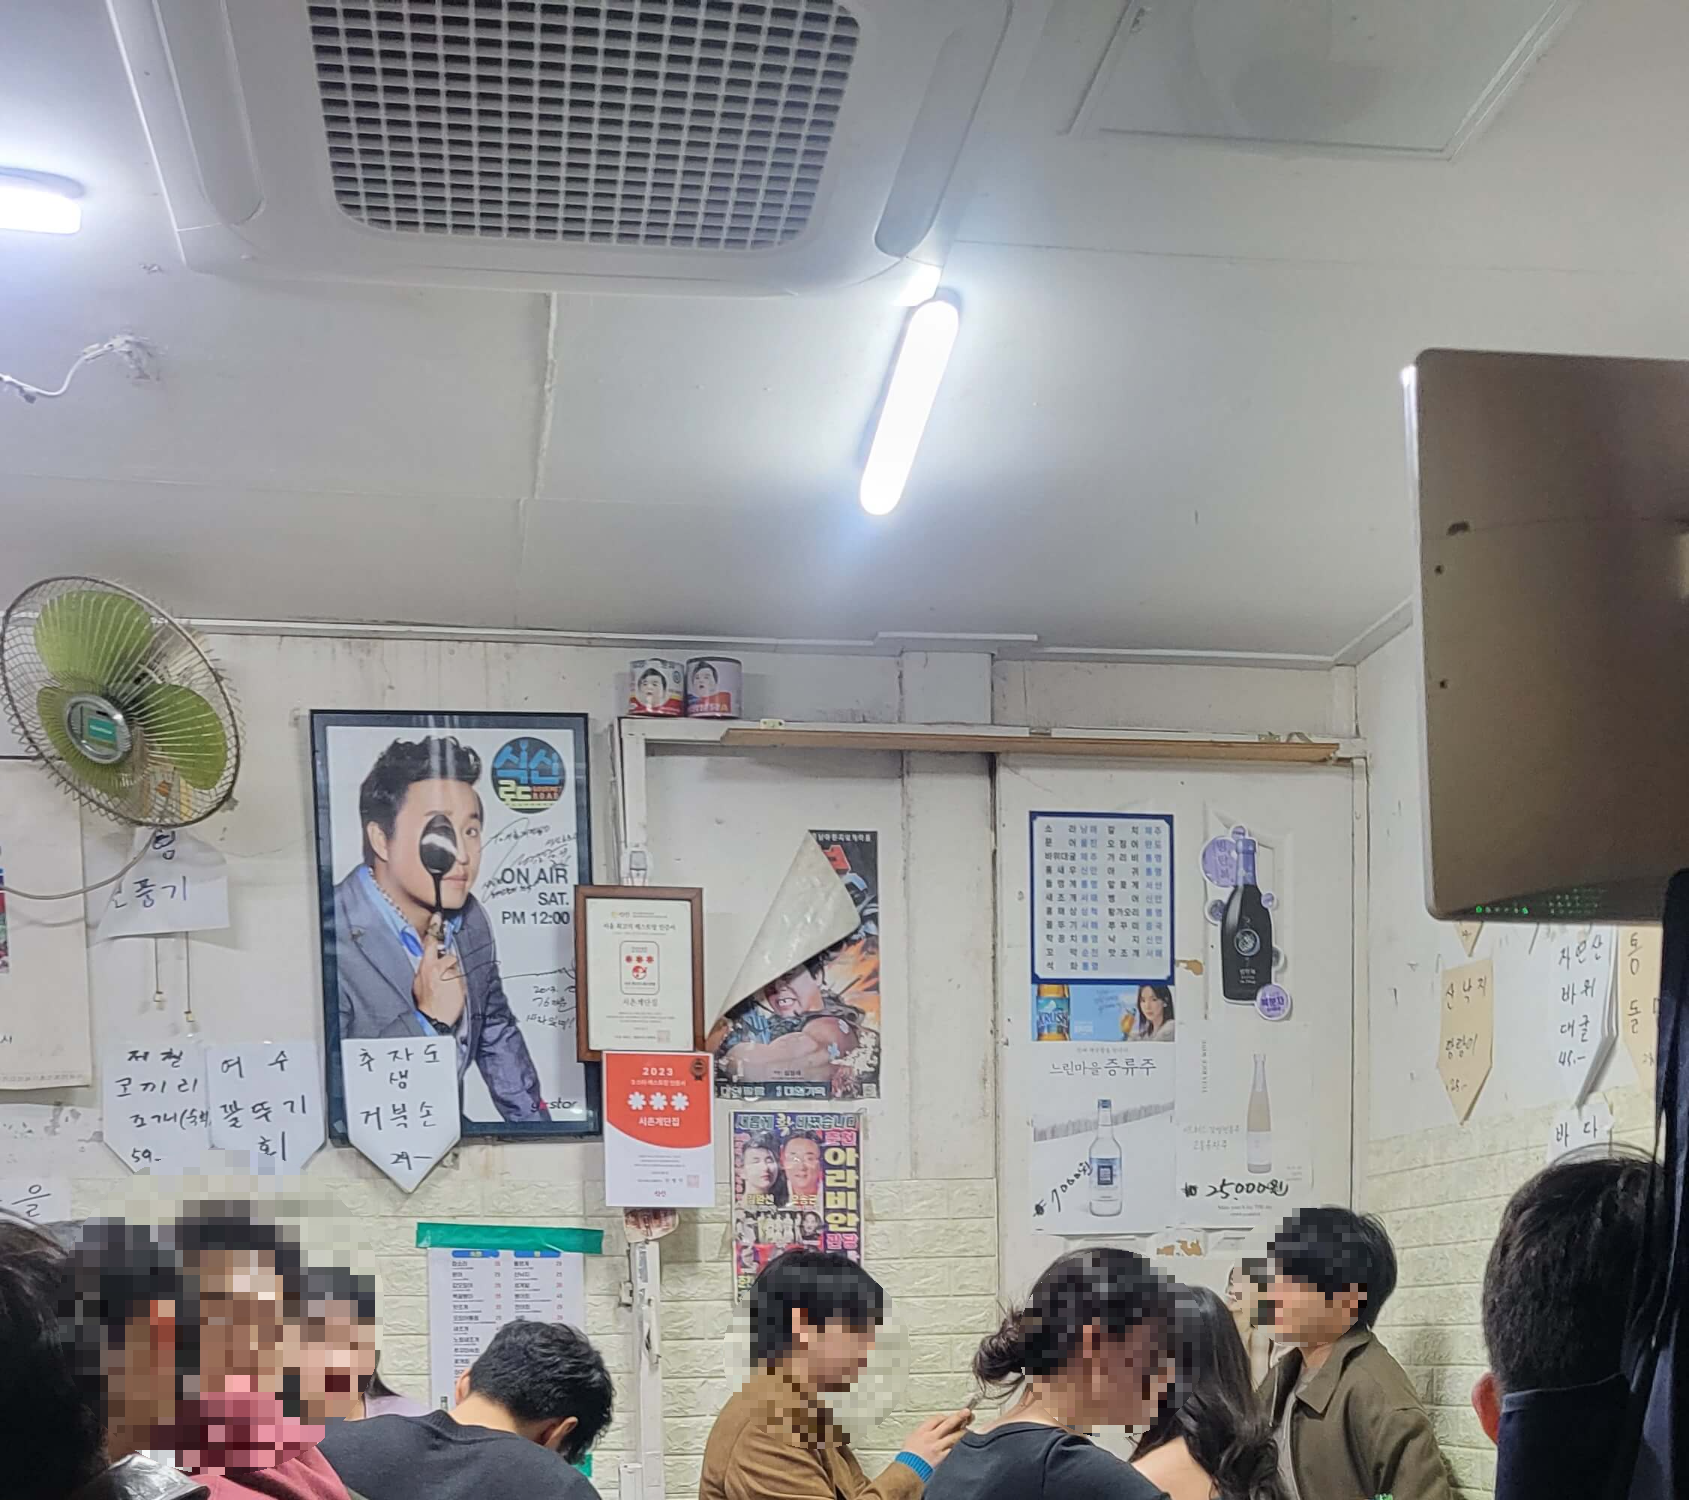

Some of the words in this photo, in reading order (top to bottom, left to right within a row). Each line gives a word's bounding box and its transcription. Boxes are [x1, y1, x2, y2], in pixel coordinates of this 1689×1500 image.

[494, 738, 560, 785] 식신
[501, 867, 530, 885] ON
[536, 867, 569, 885] AIR
[537, 892, 570, 907] SAT.
[501, 911, 526, 925] PM
[531, 911, 571, 925] 12:00
[358, 1043, 441, 1072] 추자도
[1049, 1061, 1102, 1076] 느린마을
[1103, 1057, 1157, 1077] 증류주
[389, 1069, 410, 1090] 생
[641, 1067, 674, 1077] 2023
[114, 1077, 198, 1098] 코끼리
[360, 1101, 437, 1131] 거북손
[824, 1147, 860, 1232] 아라비안
